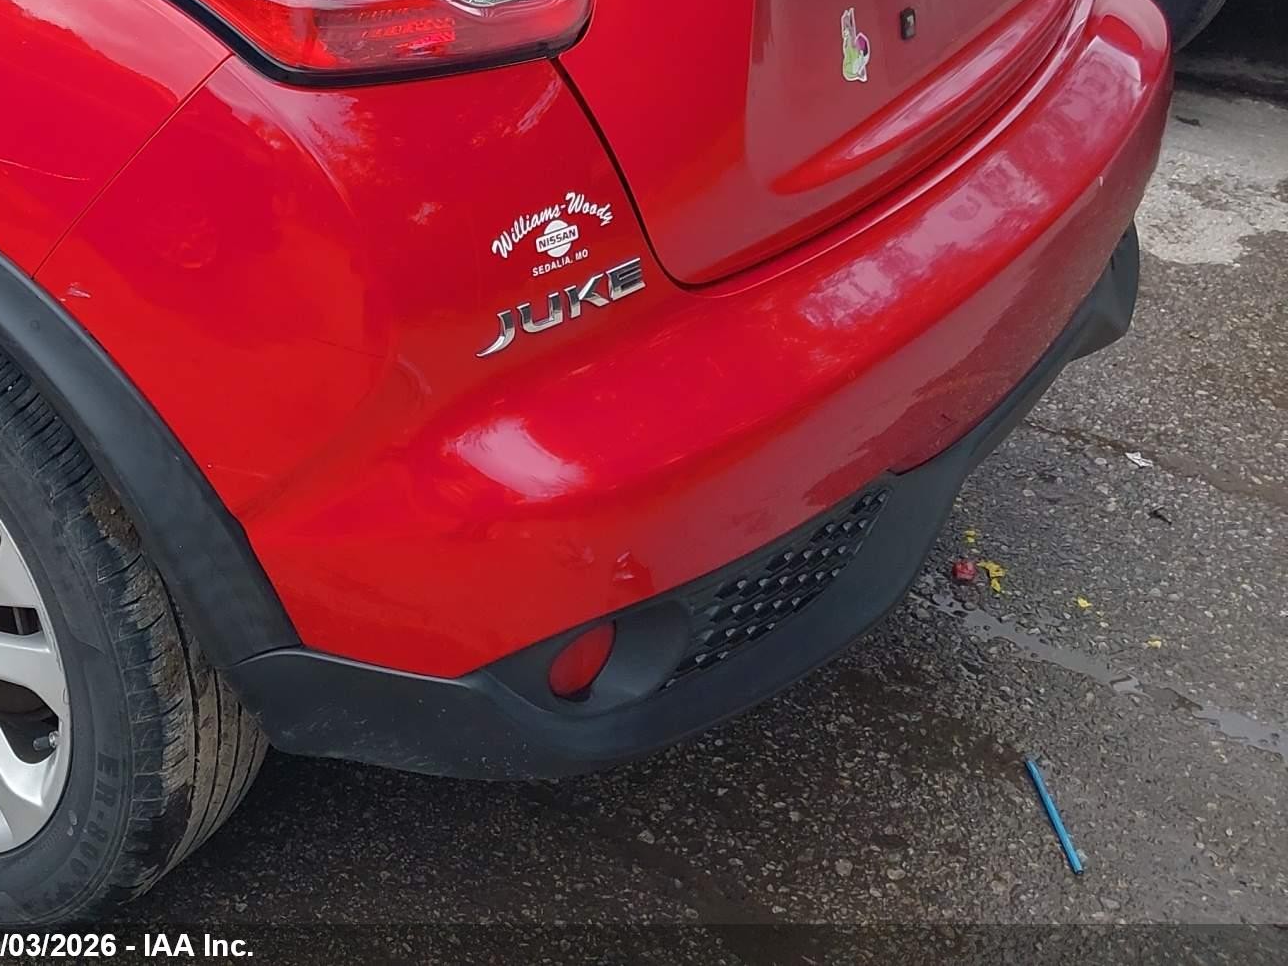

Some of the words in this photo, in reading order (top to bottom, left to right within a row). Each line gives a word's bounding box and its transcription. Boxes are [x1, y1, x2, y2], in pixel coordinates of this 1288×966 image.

[491, 191, 614, 259] Williams-Woody
[537, 226, 577, 250] NISSAN
[575, 248, 589, 261] MO
[475, 257, 646, 357] JUKE
